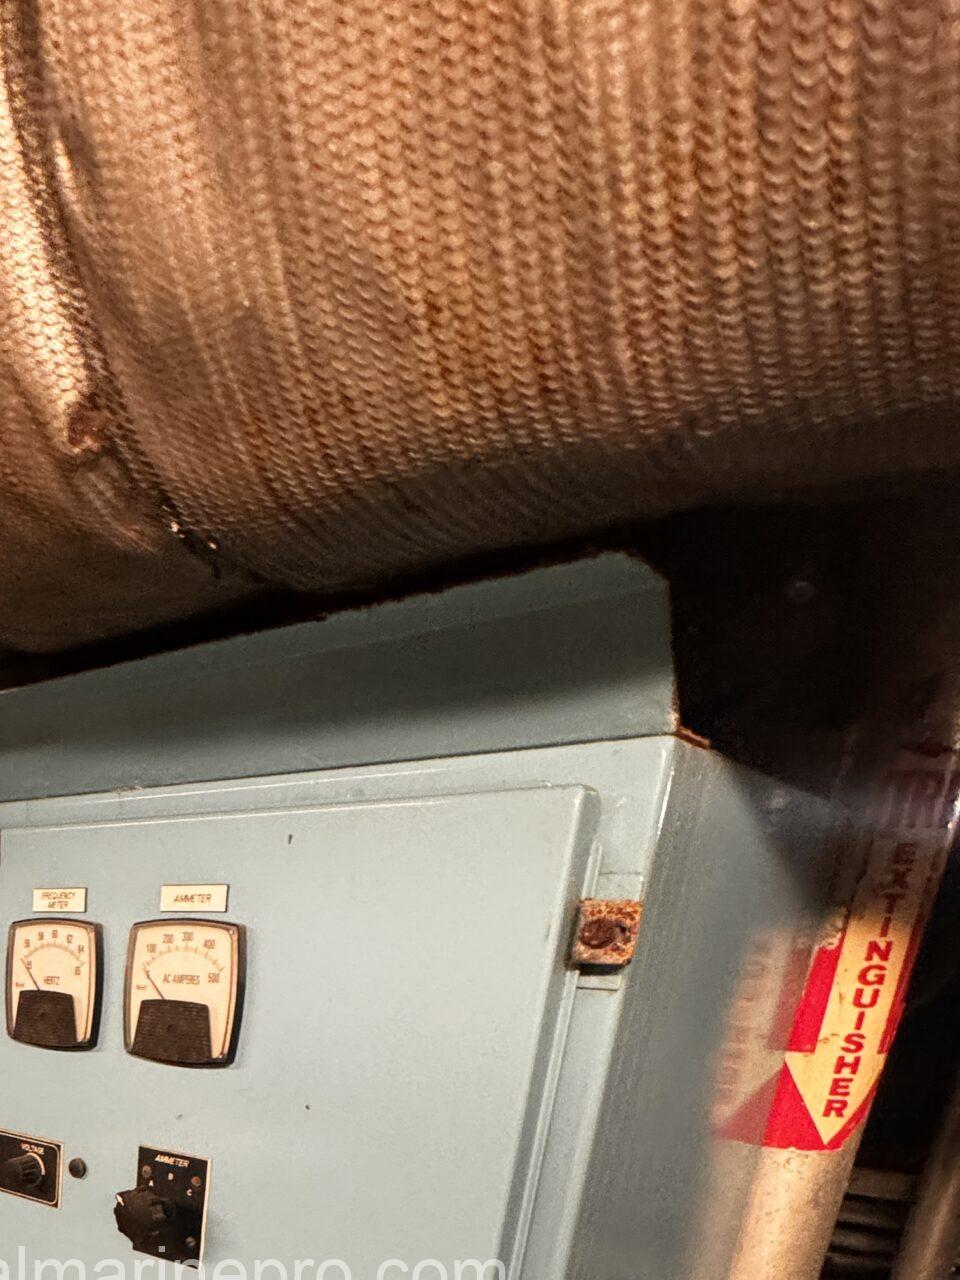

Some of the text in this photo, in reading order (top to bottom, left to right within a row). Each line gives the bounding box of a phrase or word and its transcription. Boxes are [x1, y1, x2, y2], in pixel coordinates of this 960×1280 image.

[41, 891, 77, 900] FREQUENCY
[173, 893, 213, 904] AMMETER
[47, 901, 69, 909] METER
[163, 934, 175, 944] 200
[182, 931, 193, 941] 300
[146, 943, 157, 953] 100
[204, 939, 216, 949] 400
[162, 973, 200, 985] AC AMPERES
[208, 972, 220, 984] 500
[823, 842, 915, 1118] EXTINGUISHER
[21, 1142, 45, 1155] VOLTAGE
[154, 1154, 190, 1168] AMMETER
